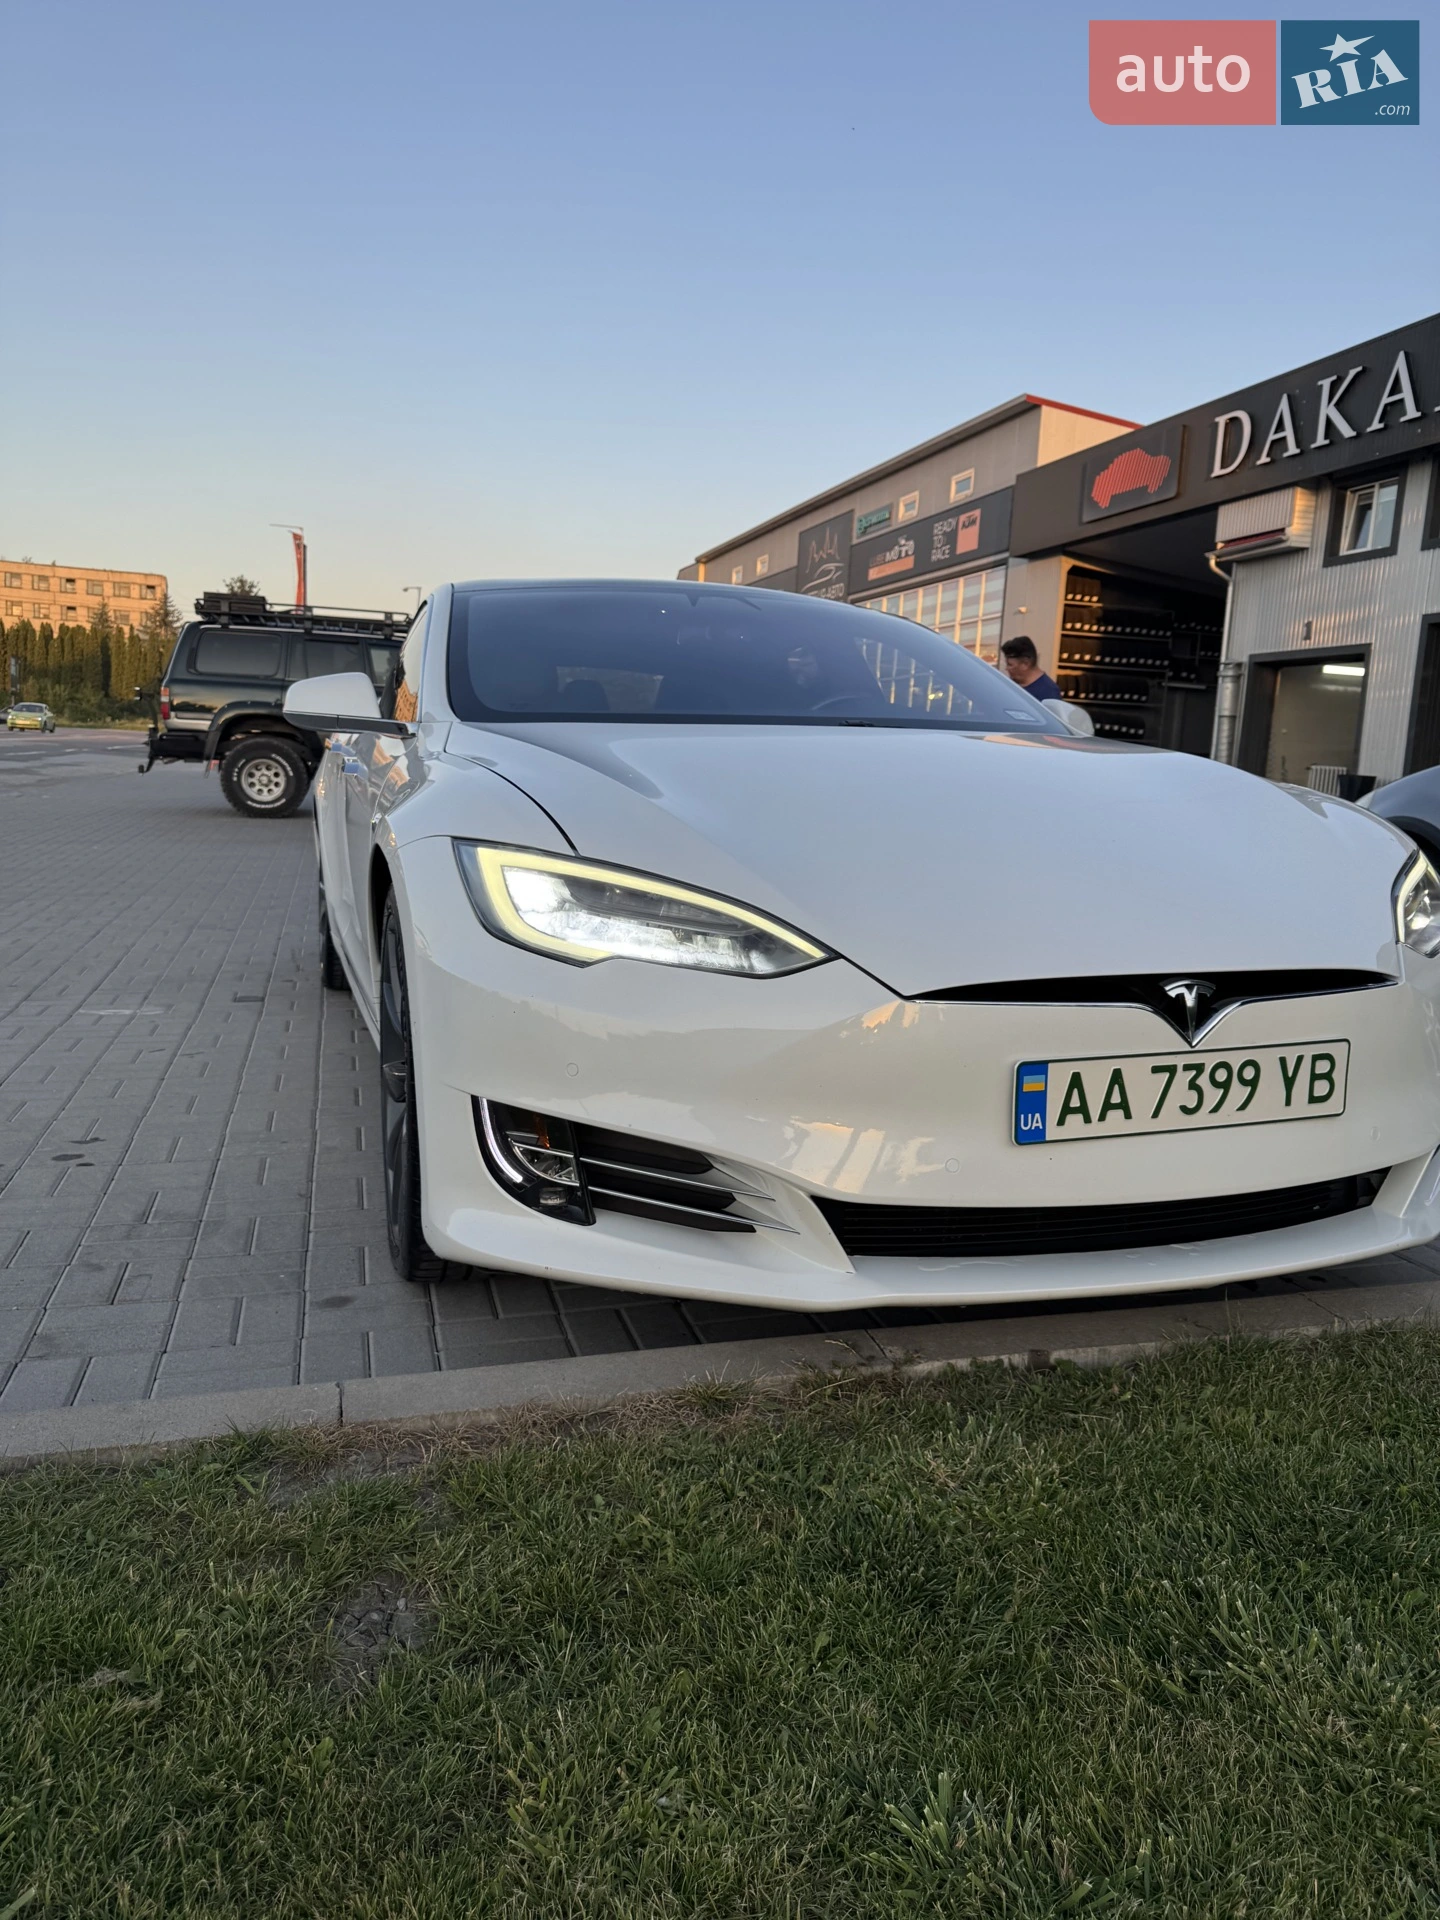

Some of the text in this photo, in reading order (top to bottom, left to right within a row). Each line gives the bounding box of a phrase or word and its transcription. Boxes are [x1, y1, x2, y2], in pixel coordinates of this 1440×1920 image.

[1210, 350, 1440, 478] DAKA
[933, 516, 958, 535] READY
[961, 515, 978, 531] KTM
[932, 535, 944, 549] TO
[931, 545, 951, 562] RACE
[1056, 1052, 1336, 1127] AA 7399 YB
[1020, 1113, 1043, 1131] UA
